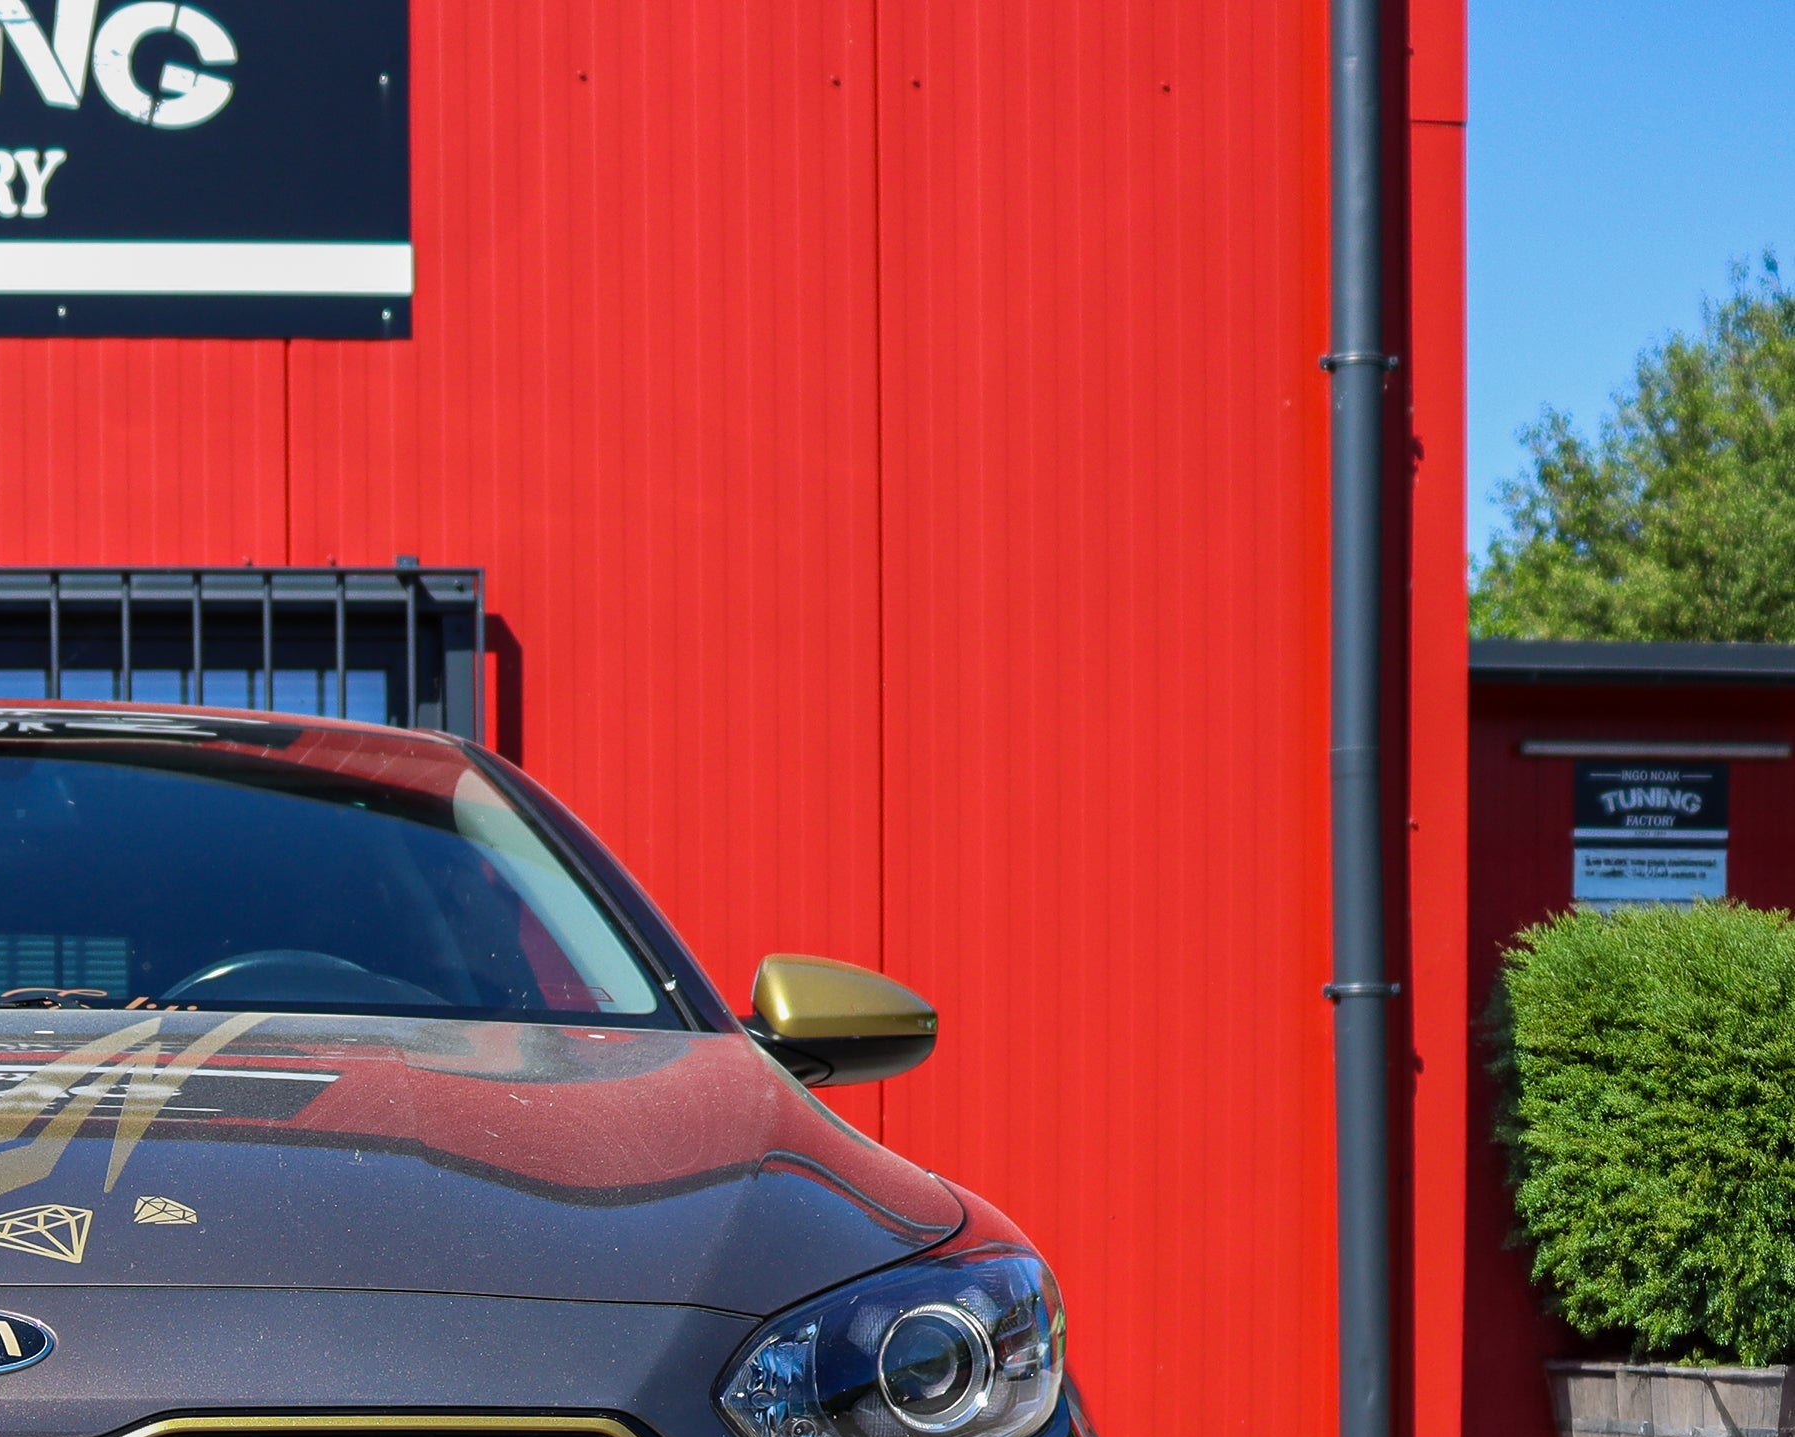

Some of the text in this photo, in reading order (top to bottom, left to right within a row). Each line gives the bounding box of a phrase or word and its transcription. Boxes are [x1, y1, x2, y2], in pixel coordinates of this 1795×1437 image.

[1621, 770, 1680, 782] INGO NOAK
[1600, 787, 1703, 814] TUNING
[1625, 815, 1677, 828] FACTORY
